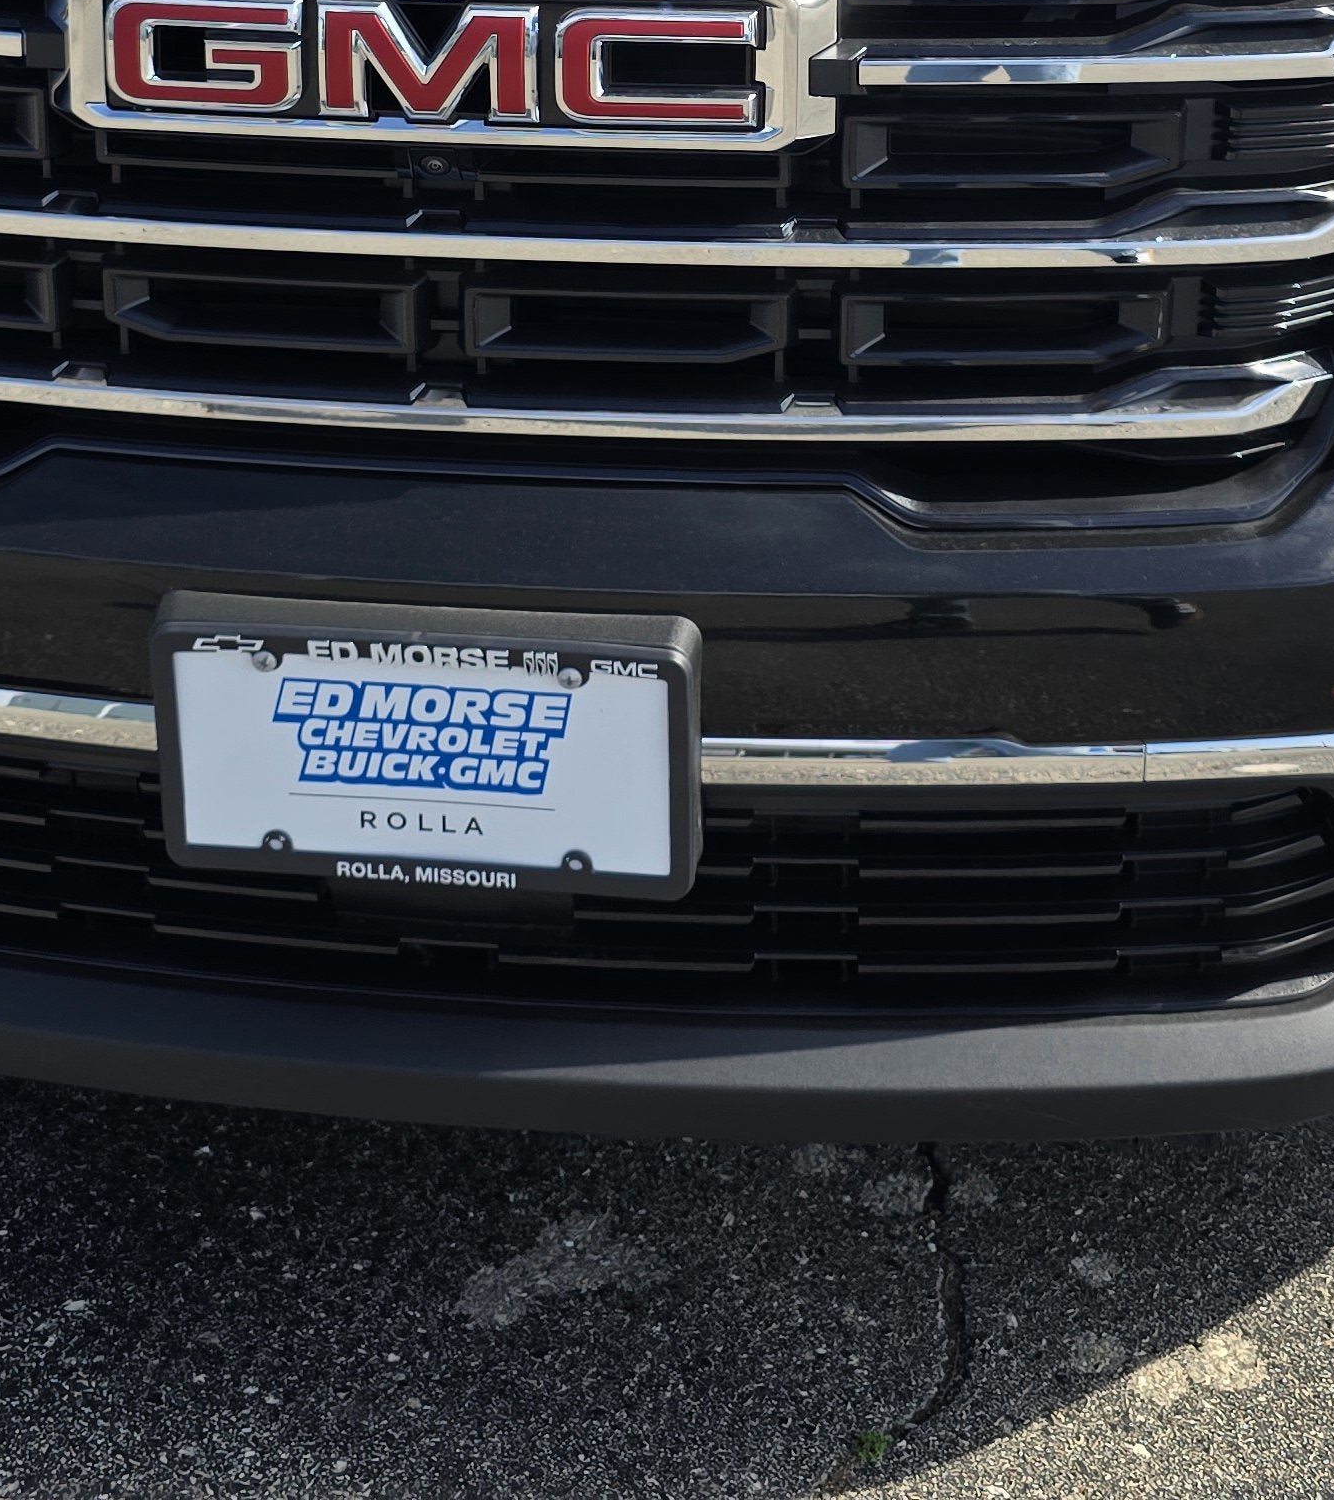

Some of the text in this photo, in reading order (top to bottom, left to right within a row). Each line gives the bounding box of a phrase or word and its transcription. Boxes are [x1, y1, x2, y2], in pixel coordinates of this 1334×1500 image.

[307, 639, 510, 671] ED MORSE
[589, 658, 660, 679] GMC
[278, 682, 567, 730] ED MORSE
[299, 717, 548, 759] CHEVROLET
[360, 810, 484, 836] ROLLA
[336, 861, 517, 890] ROLLA, MISSOURI
